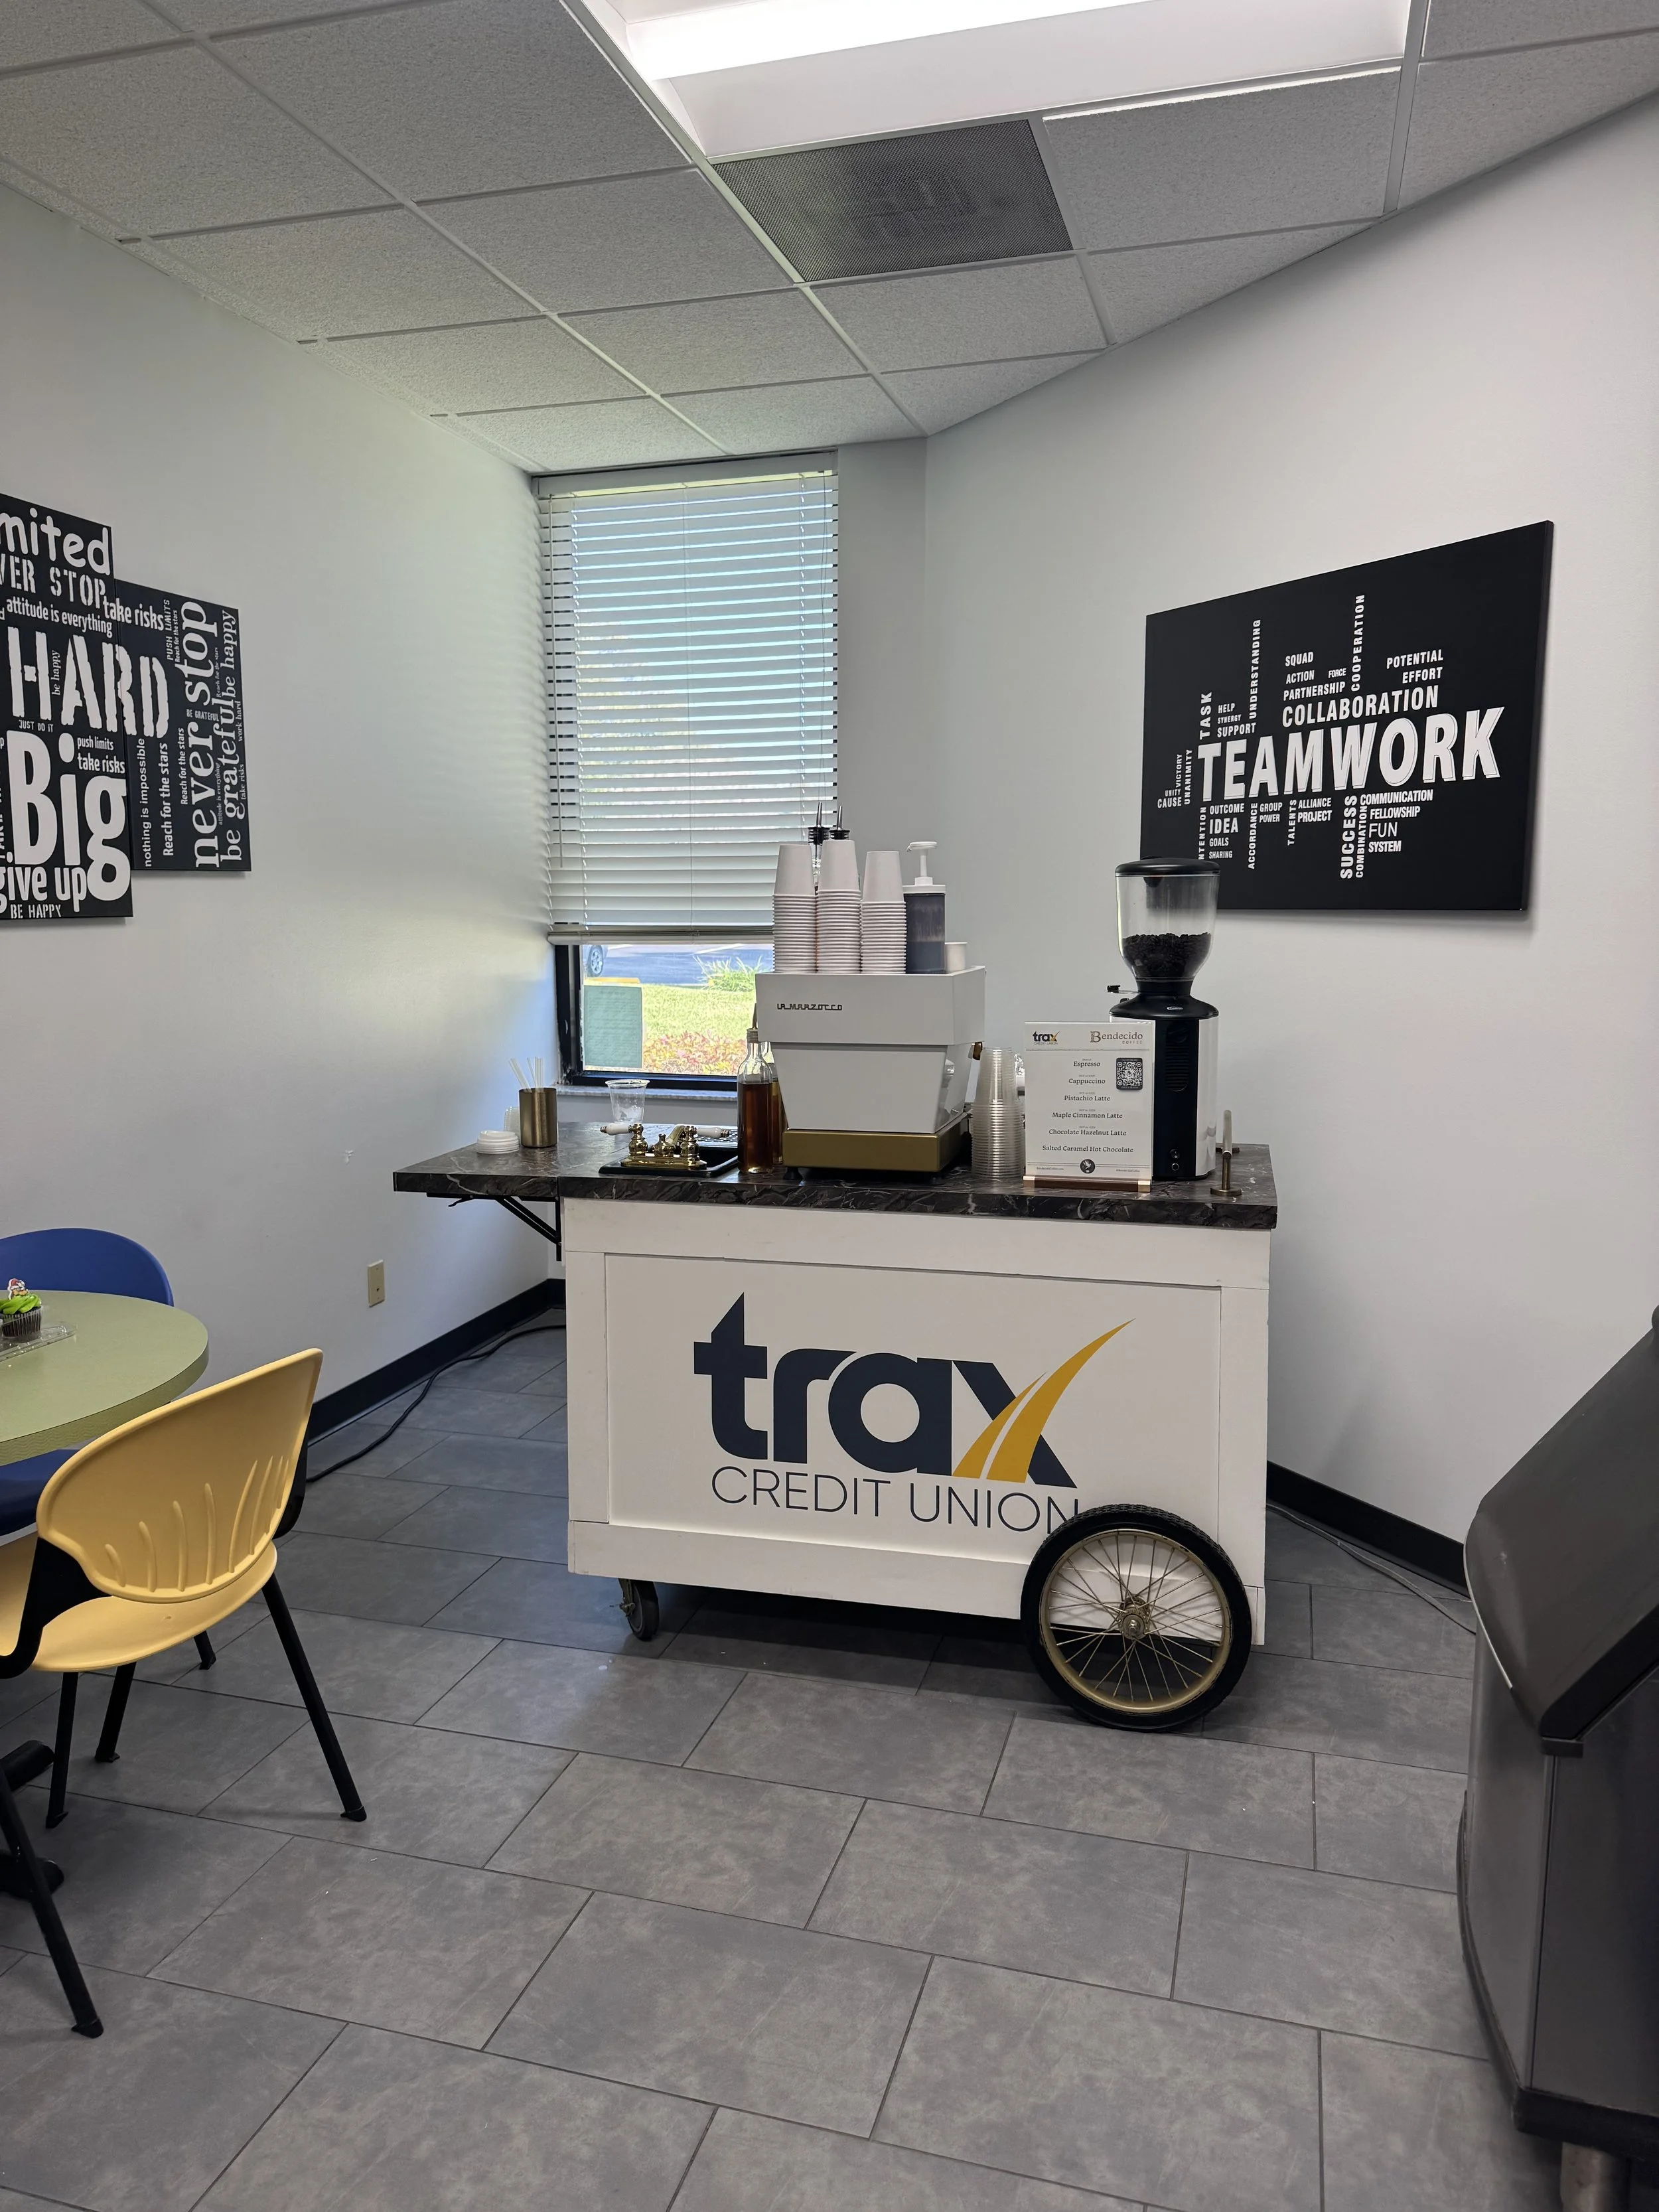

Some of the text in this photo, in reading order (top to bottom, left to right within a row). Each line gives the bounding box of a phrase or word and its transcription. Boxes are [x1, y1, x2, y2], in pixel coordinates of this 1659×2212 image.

[50, 567, 106, 609] STOP
[7, 596, 48, 620] attitude
[50, 604, 59, 623] is
[62, 612, 112, 637] everything
[103, 595, 164, 630] take risks
[163, 599, 172, 631] LIMITS
[1351, 595, 1365, 692] COOPERATION
[220, 610, 238, 698] be happy
[1285, 651, 1314, 667] SQUAD
[1386, 649, 1443, 669] POTENTIAL
[51, 650, 61, 696] be happy
[1249, 619, 1261, 719] UNDERSTANDING
[1285, 670, 1315, 684] ACTION
[1328, 668, 1346, 678] FORCE
[1402, 666, 1443, 684] EFFORT
[8, 627, 169, 739] HARD
[1283, 681, 1346, 701] PARTNERSHIP
[186, 709, 219, 722] BE GRATEFUL
[1199, 692, 1212, 740] TASK
[1218, 703, 1235, 713] HELP
[1282, 685, 1439, 727] COLLABORATION
[19, 719, 35, 730] JUST
[1217, 714, 1242, 724] SYNERGY
[175, 601, 220, 868] never stop
[1217, 722, 1257, 738] SUPPORT
[77, 736, 113, 751] push limits
[77, 753, 125, 774] take risks
[1197, 706, 1505, 802] TEAMWORK
[211, 698, 245, 862] be grateful
[1184, 749, 1192, 805] UNANIMITY
[137, 738, 152, 867] nothing is impossible
[158, 742, 174, 855] Reach for the stars
[179, 782, 188, 804] Reach
[1157, 796, 1182, 808] CAUSE
[1165, 788, 1181, 797] UNITY
[1360, 789, 1433, 806] COMMUNICATION
[1210, 803, 1244, 815] OUTCOME
[1260, 802, 1283, 812] GROUP
[1298, 797, 1332, 809] ALLIANCE
[1370, 806, 1421, 820] FELLOWSHIP
[7, 730, 131, 901] Big
[1209, 817, 1238, 834] IDEA
[1259, 814, 1280, 823] POWER
[1287, 799, 1297, 846] TALENTS
[1297, 810, 1333, 823] PROJECT
[1248, 802, 1258, 869] ACCORDANCE
[1340, 795, 1357, 879] SUCCESS
[1368, 822, 1398, 838] FUN
[1209, 837, 1229, 847] GOALS
[1356, 806, 1367, 878] COMBINATION
[1368, 840, 1402, 853] SYSTEM
[1208, 851, 1233, 859] SHARING
[54, 867, 87, 912] up
[11, 903, 62, 919] BE HAPPY
[1033, 1031, 1060, 1042] trax
[1090, 1031, 1143, 1043] Bendecido
[694, 1291, 1136, 1489] trax
[711, 1465, 1078, 1534] CREDIT UNION
